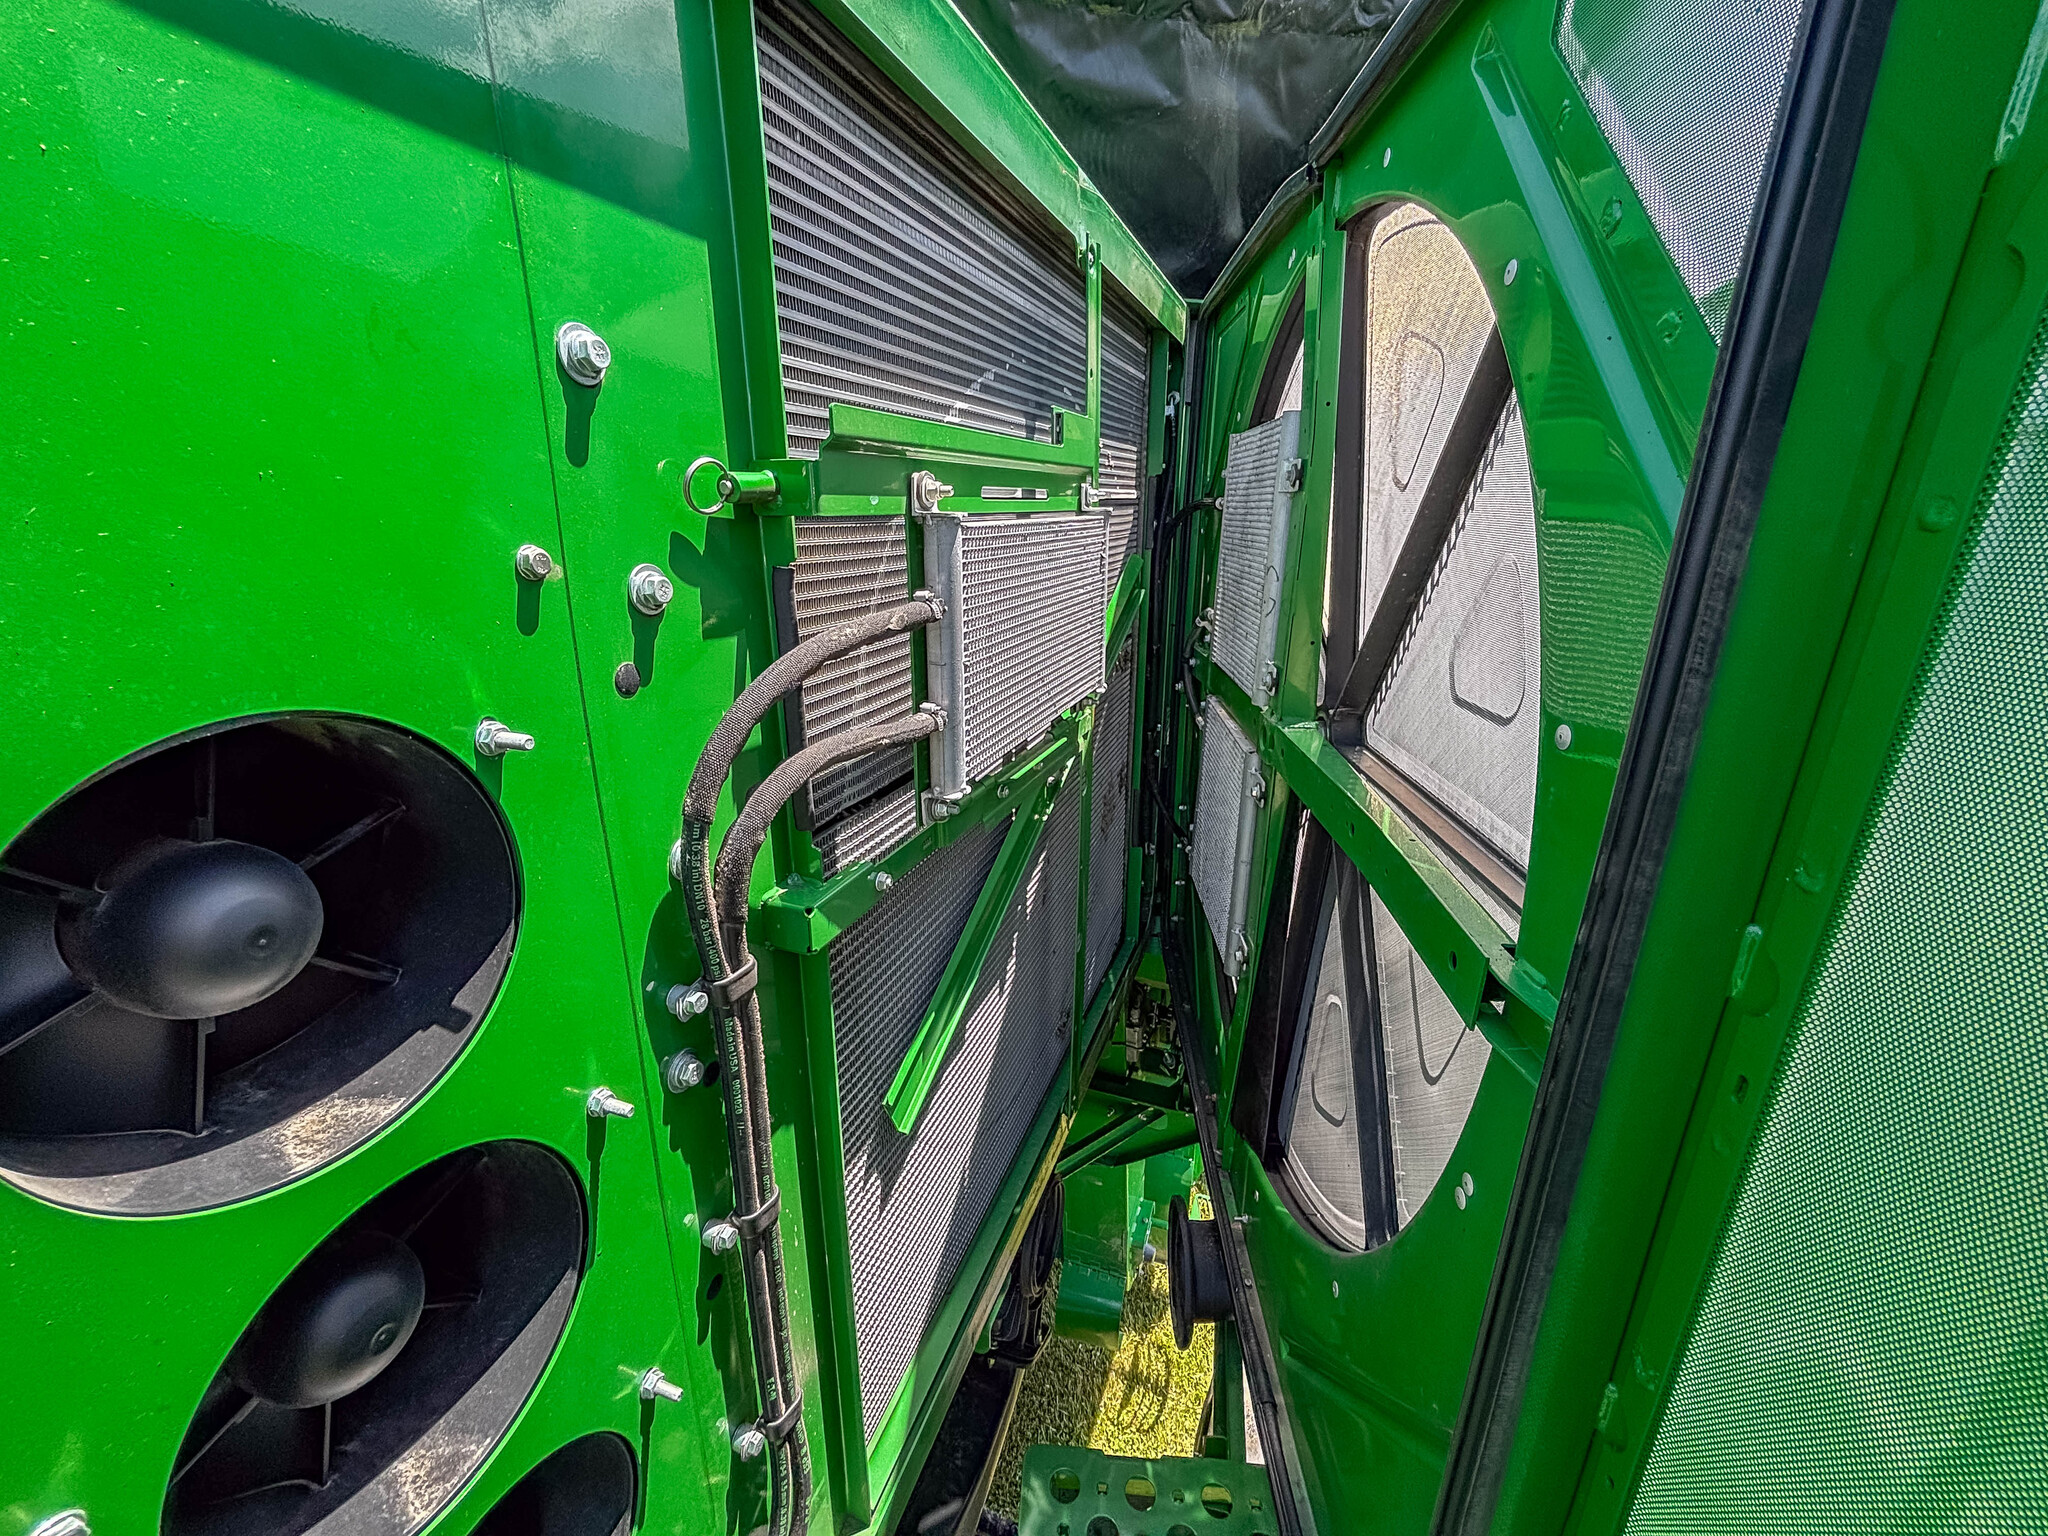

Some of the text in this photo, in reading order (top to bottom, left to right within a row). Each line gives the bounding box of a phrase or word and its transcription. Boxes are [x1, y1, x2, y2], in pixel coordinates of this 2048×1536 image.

[693, 884, 706, 911] DN10
[700, 918, 710, 930] 28
[702, 930, 714, 946] bar
[706, 944, 720, 964] (400
[728, 1052, 739, 1073] USA
